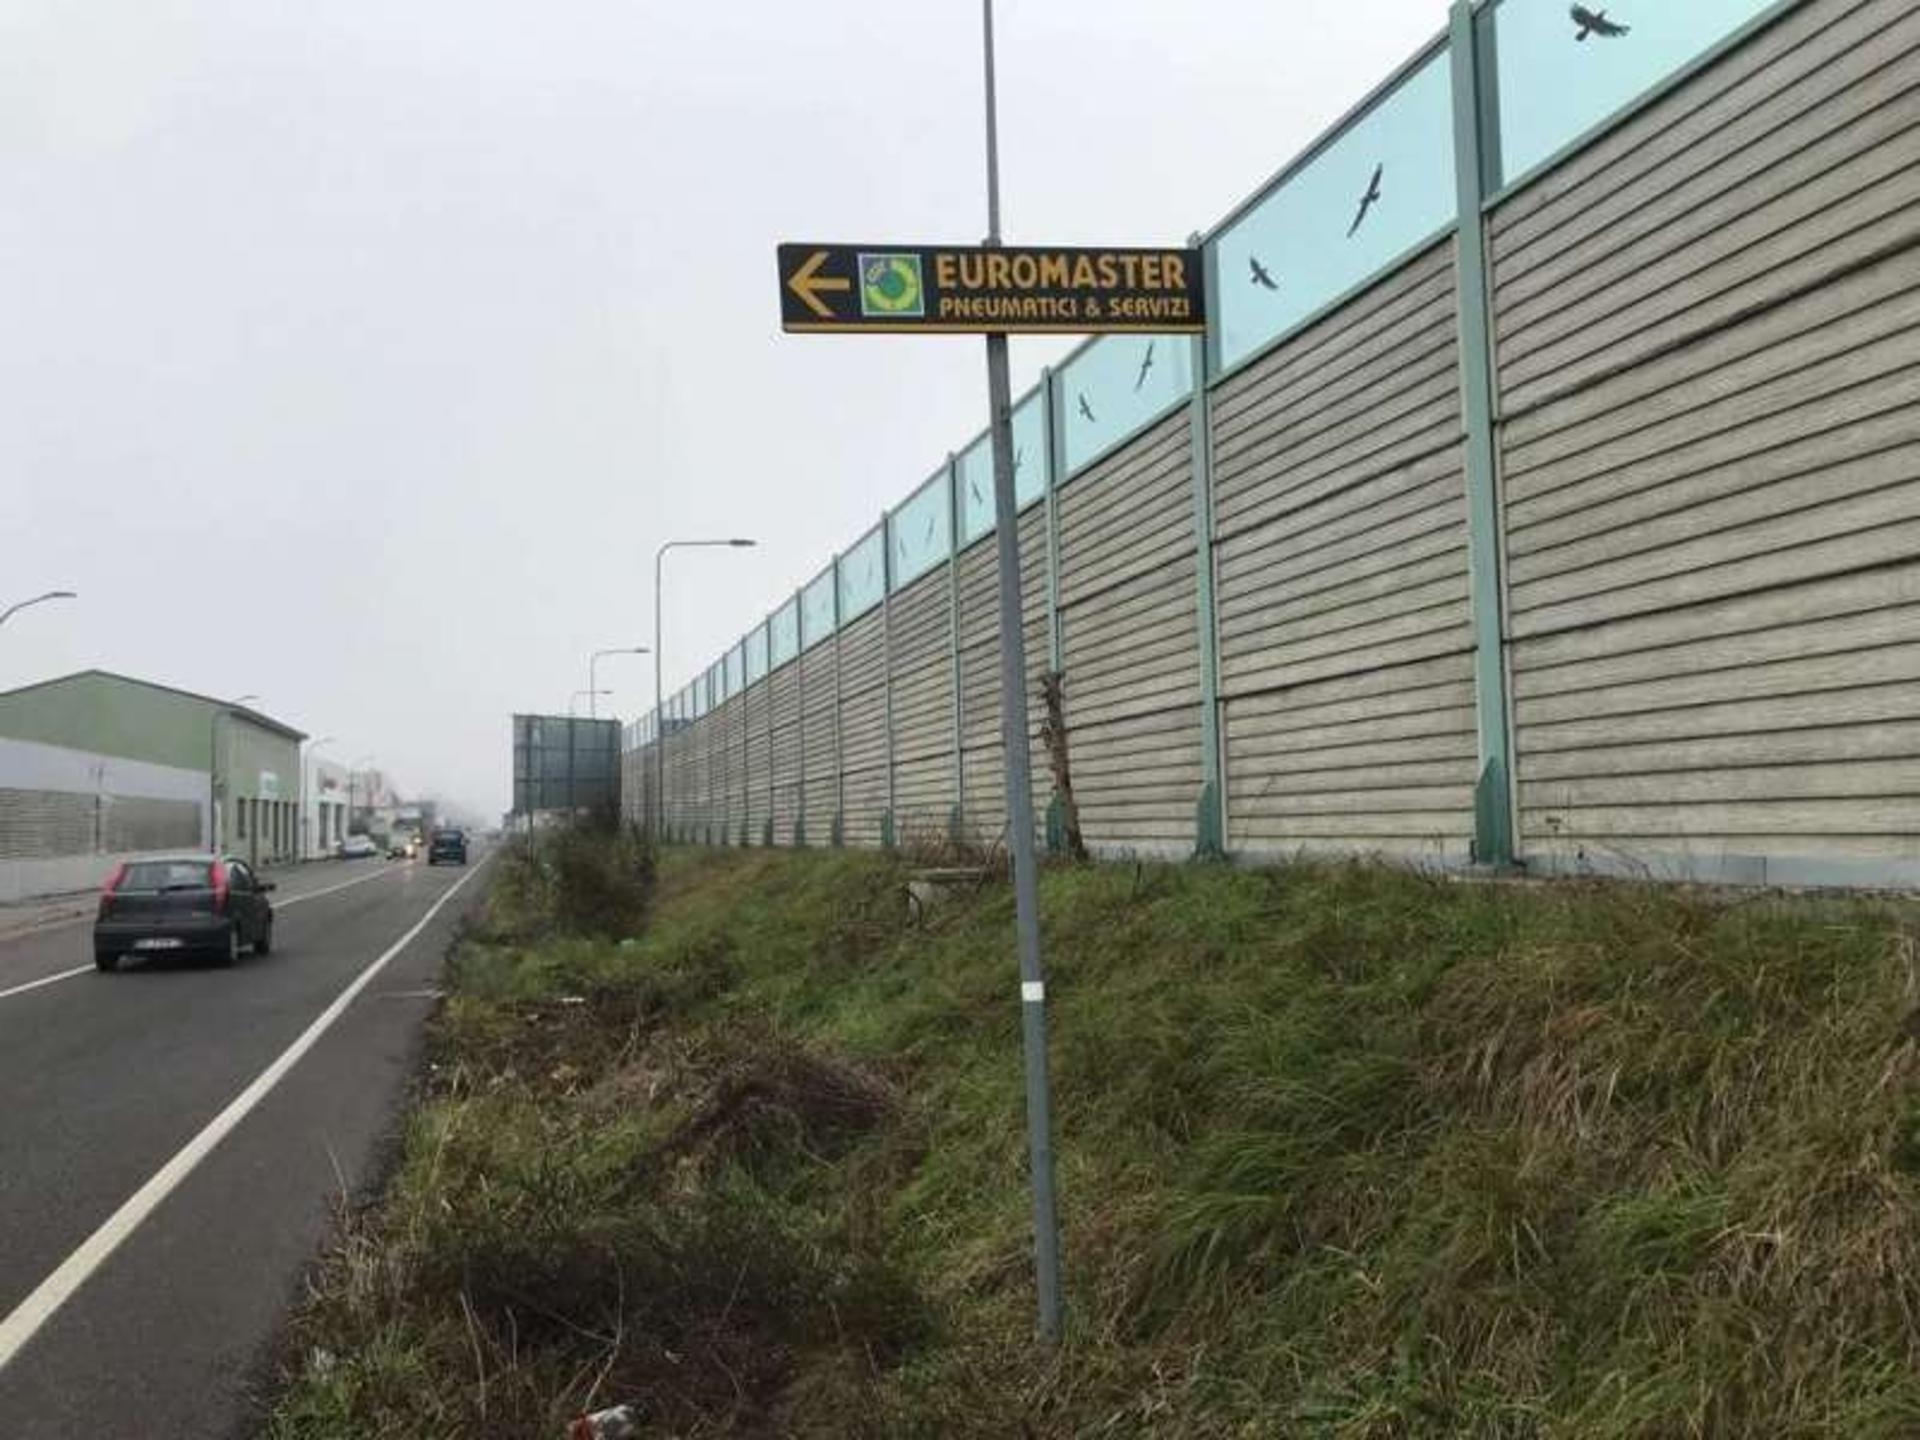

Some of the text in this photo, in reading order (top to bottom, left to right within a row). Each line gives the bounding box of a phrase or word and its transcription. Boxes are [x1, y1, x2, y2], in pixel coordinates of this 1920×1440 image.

[936, 254, 1186, 289] EUROMASTER
[940, 297, 1190, 318] PNEUMATICI & SERVIZI
